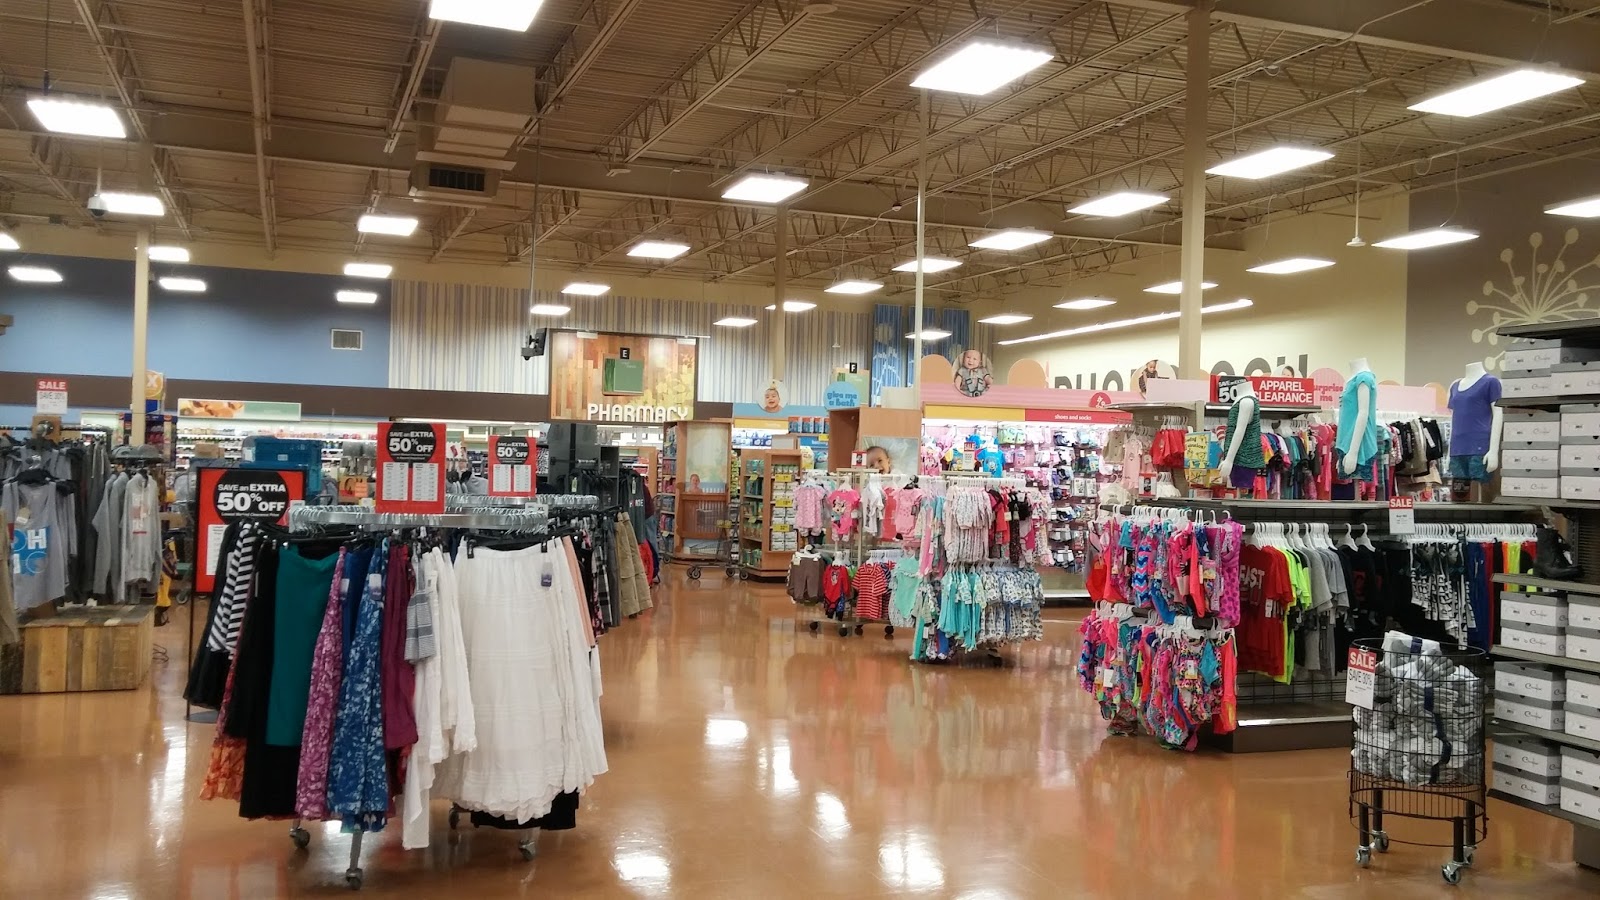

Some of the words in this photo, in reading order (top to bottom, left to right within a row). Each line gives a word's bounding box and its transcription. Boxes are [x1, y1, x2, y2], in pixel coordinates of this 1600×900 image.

[622, 349, 628, 358] E
[851, 364, 856, 372] F
[38, 381, 66, 390] SALE
[1260, 380, 1305, 391] APPAREL
[1314, 383, 1344, 394] urprise
[827, 391, 843, 400] give
[1254, 392, 1312, 403] CLEARANCE
[835, 398, 855, 406] bath
[587, 402, 689, 422] PHARMACY
[388, 438, 418, 452] 50%
[416, 444, 434, 453] OFF
[217, 483, 239, 491] SAVE
[249, 483, 286, 492] EXTRA
[216, 492, 262, 511] 50%
[257, 501, 286, 512] OFF
[1390, 498, 1412, 508] SALE
[1349, 651, 1375, 670] SALE
[1348, 668, 1361, 683] SAVE
